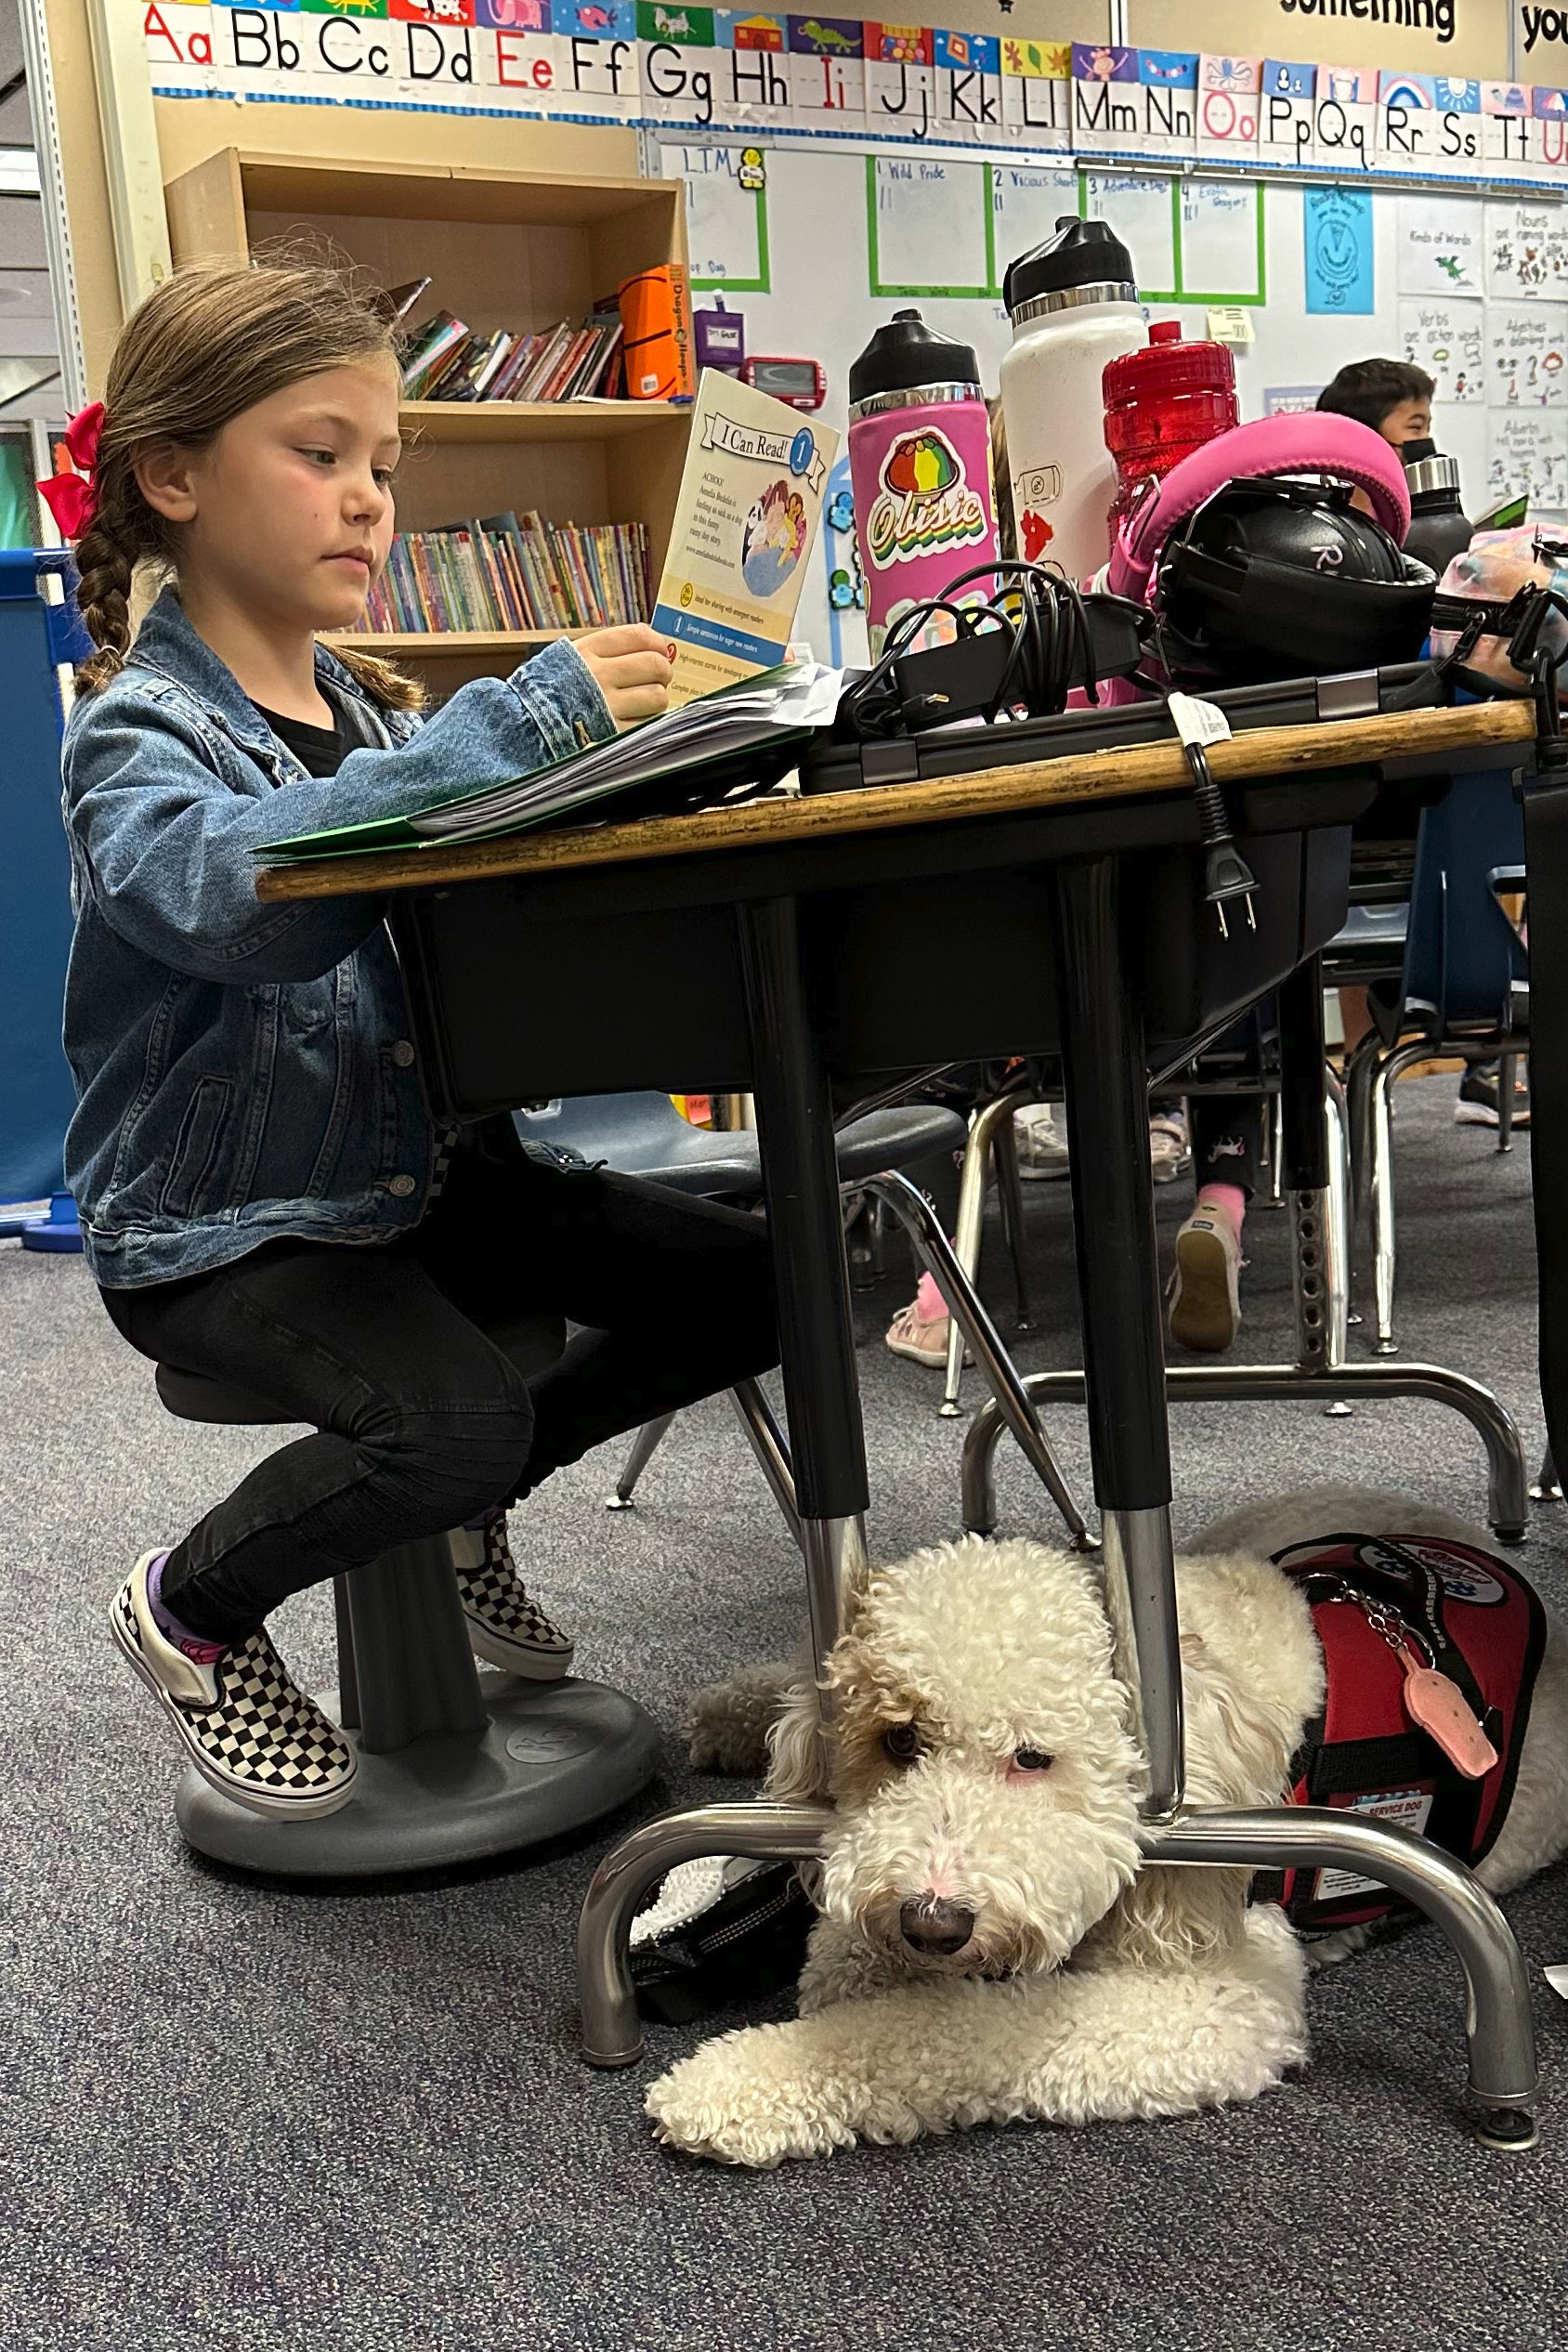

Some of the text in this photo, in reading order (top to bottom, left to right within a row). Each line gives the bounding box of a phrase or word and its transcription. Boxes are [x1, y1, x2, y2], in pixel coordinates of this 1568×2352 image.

[145, 4, 1568, 170] Aa Bb Cc Dd Ee Ff Gg Hh Ii Jj Kk Ll Mm Nn Oo Pp Qq Rr Ss Tt U
[993, 169, 1003, 187] 2
[1089, 176, 1098, 194] 3
[1182, 185, 1189, 202] 4
[1434, 230, 1445, 244] of
[673, 284, 684, 331] Dragon
[722, 425, 788, 460] I Can Read!
[796, 441, 805, 463] 1
[1310, 544, 1344, 571] R
[675, 616, 682, 634] 1
[1369, 1800, 1423, 1816] SERVICE DOG
